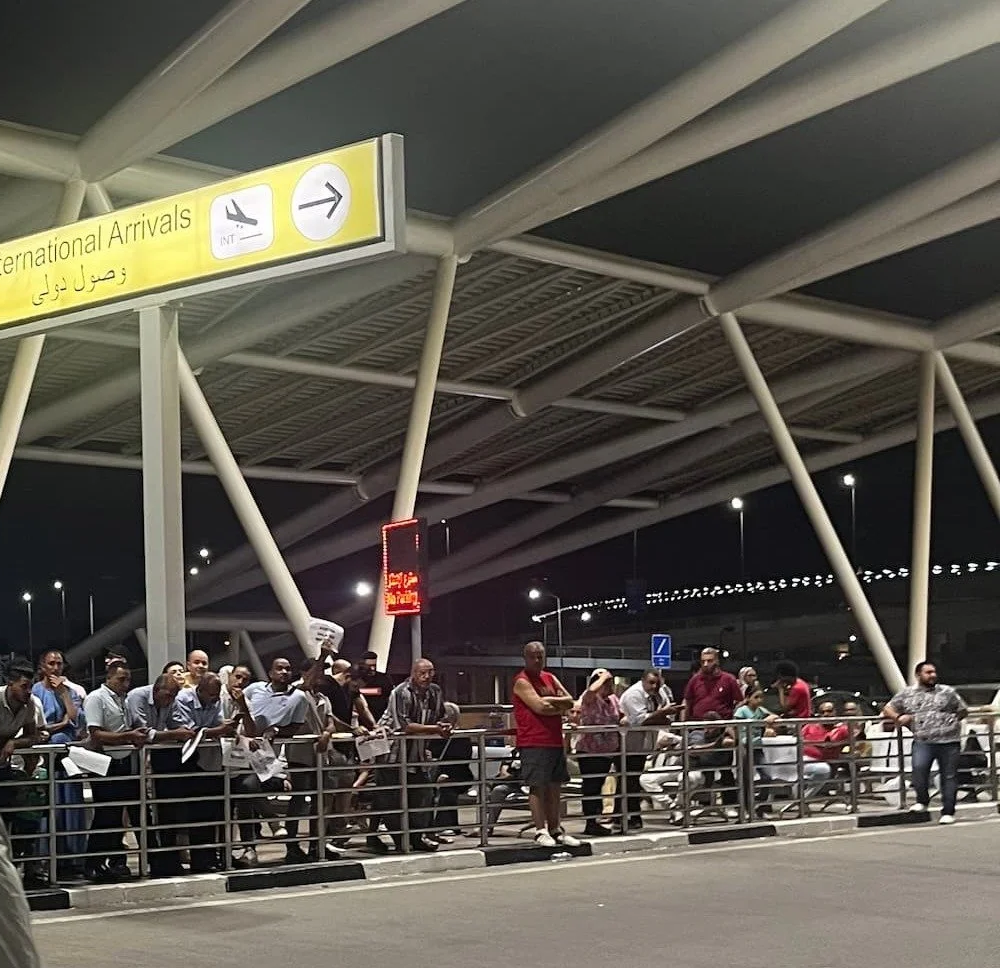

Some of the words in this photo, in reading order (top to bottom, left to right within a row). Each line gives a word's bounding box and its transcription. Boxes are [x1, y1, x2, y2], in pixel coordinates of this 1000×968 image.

[108, 204, 191, 249] Arrivals
[219, 233, 237, 247] INT
[73, 264, 127, 293] وصول
